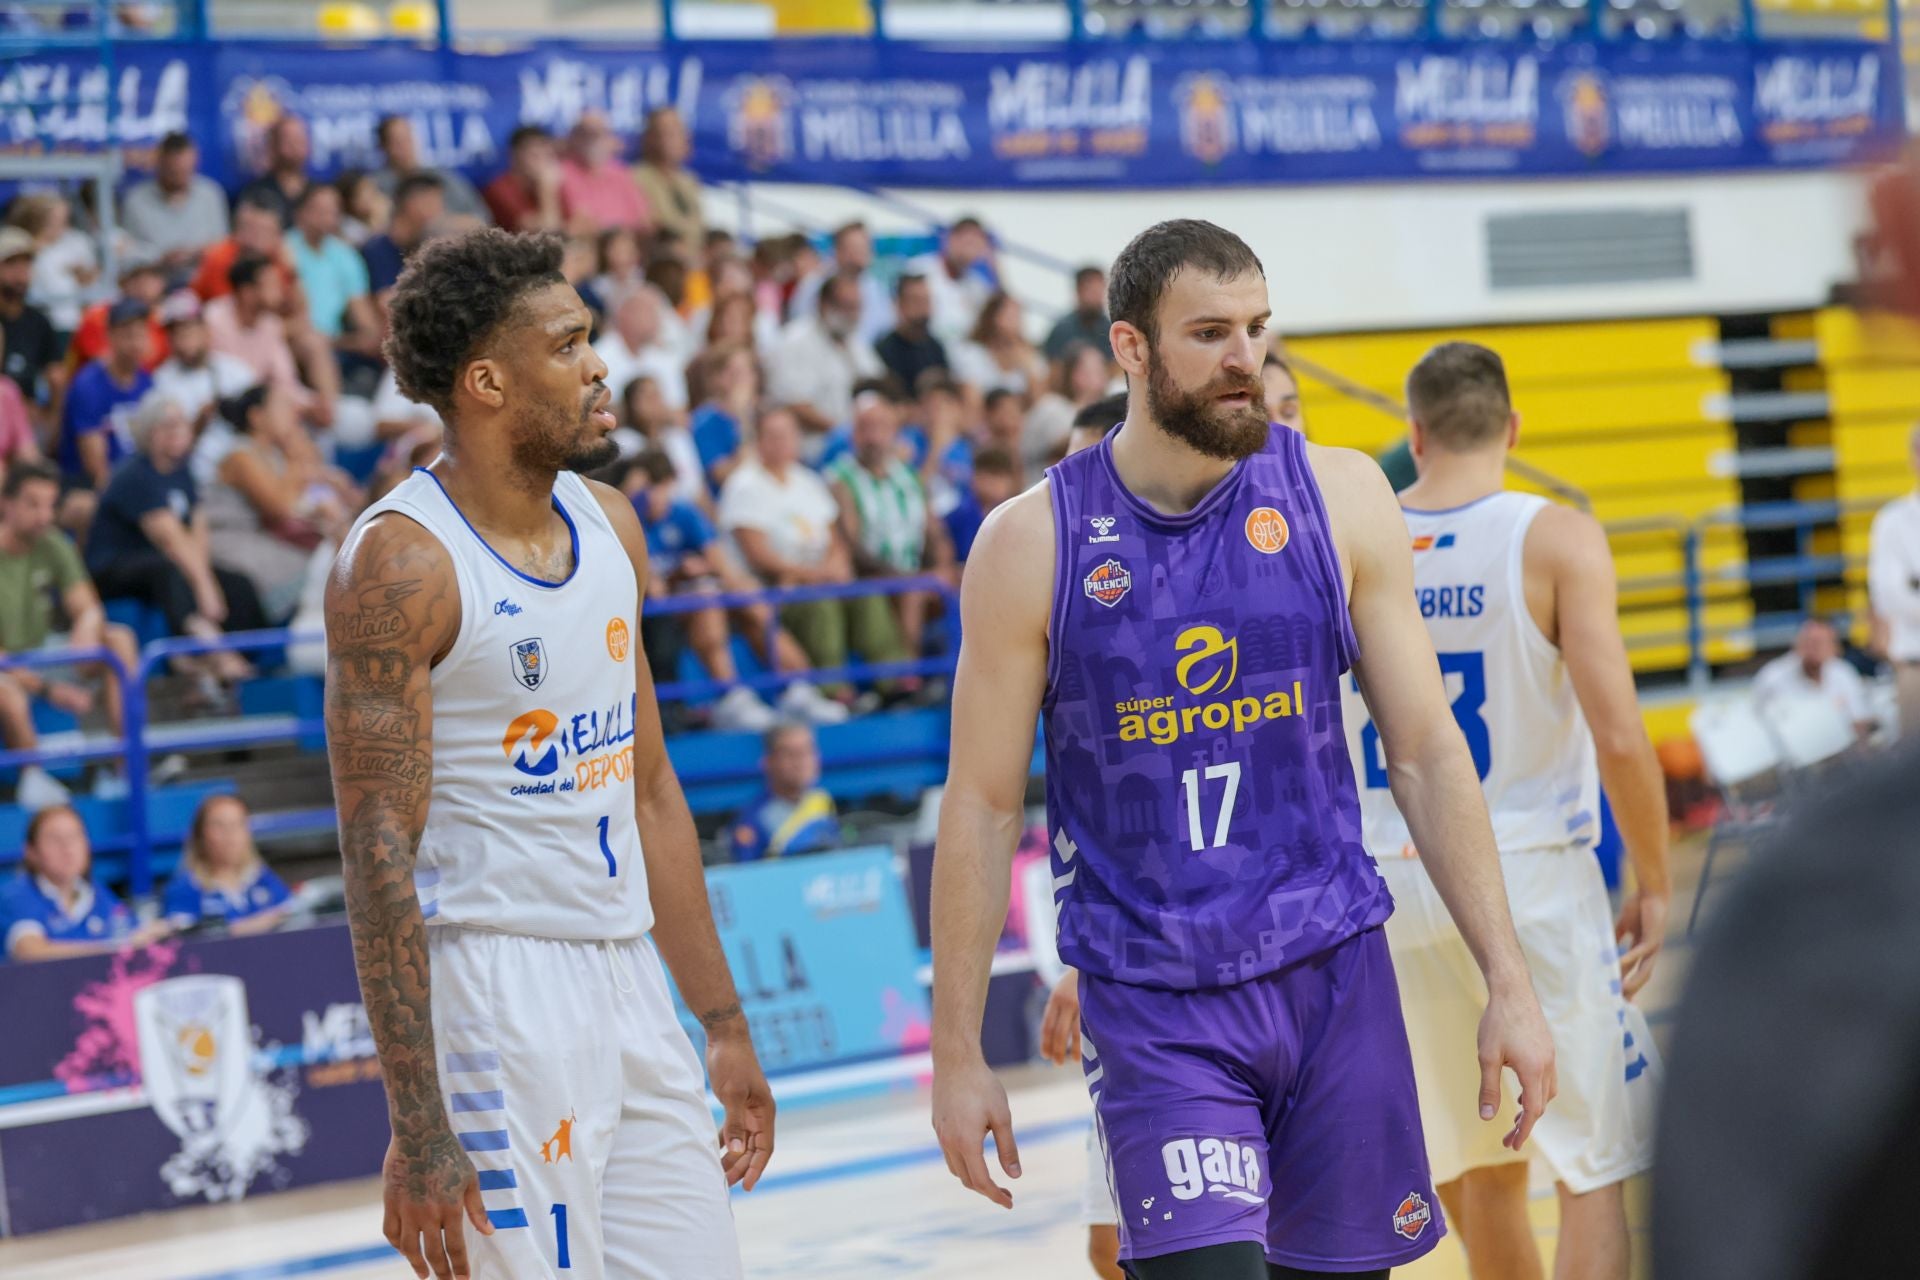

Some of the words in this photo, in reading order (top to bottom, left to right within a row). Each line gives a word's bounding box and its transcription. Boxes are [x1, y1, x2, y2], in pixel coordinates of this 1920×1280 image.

[1088, 533, 1120, 544] hummel
[1086, 575, 1129, 593] PALENCIA
[1414, 585, 1485, 618] BRIS
[1116, 695, 1175, 715] súper
[1118, 681, 1304, 746] agropal
[510, 779, 556, 796] ciudad
[559, 775, 575, 792] del
[1181, 761, 1242, 852] 17
[596, 815, 618, 878] 1
[1161, 1137, 1262, 1201] gaza
[1395, 1207, 1428, 1229] PALENCIA
[549, 1203, 571, 1269] 1
